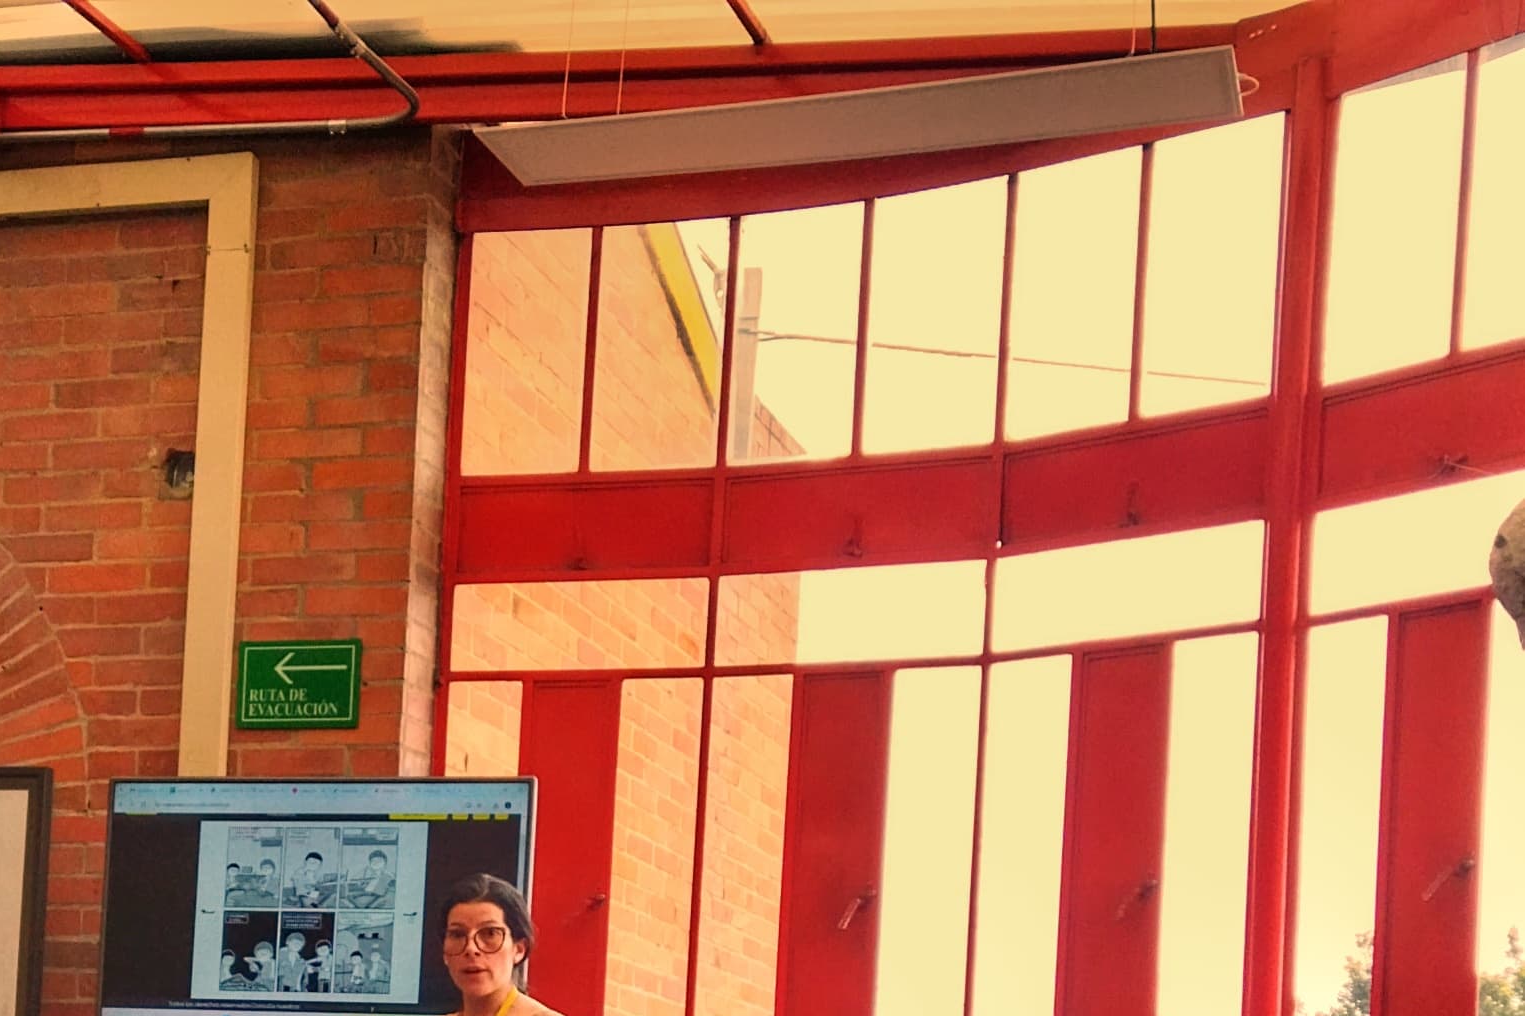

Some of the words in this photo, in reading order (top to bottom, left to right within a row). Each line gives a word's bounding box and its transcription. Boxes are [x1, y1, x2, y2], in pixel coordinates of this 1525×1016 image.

[249, 689, 285, 702] RUTA
[289, 688, 307, 701] DE
[249, 699, 339, 717] EVACUACIÓN
